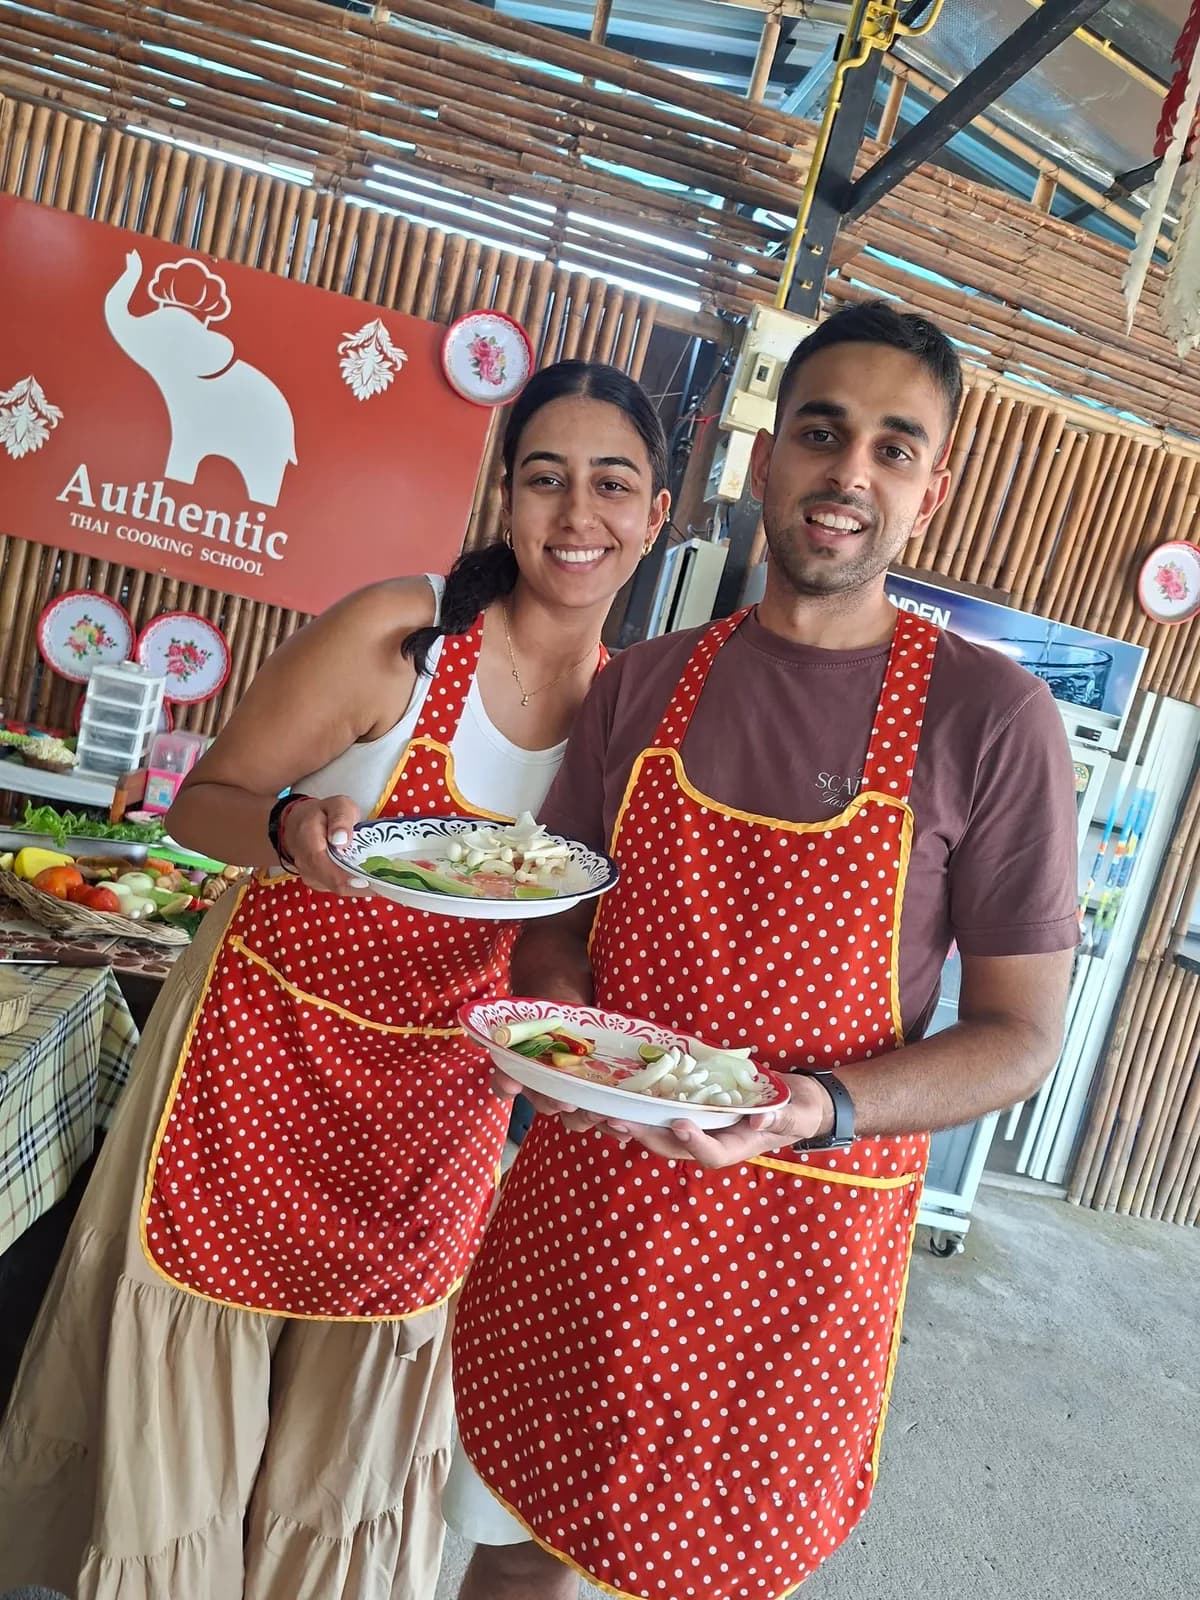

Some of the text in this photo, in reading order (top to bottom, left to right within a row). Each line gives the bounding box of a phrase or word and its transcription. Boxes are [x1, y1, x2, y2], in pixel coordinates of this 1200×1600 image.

[56, 463, 289, 561] Authentic
[69, 511, 265, 577] THAI COOKING SCHOOL
